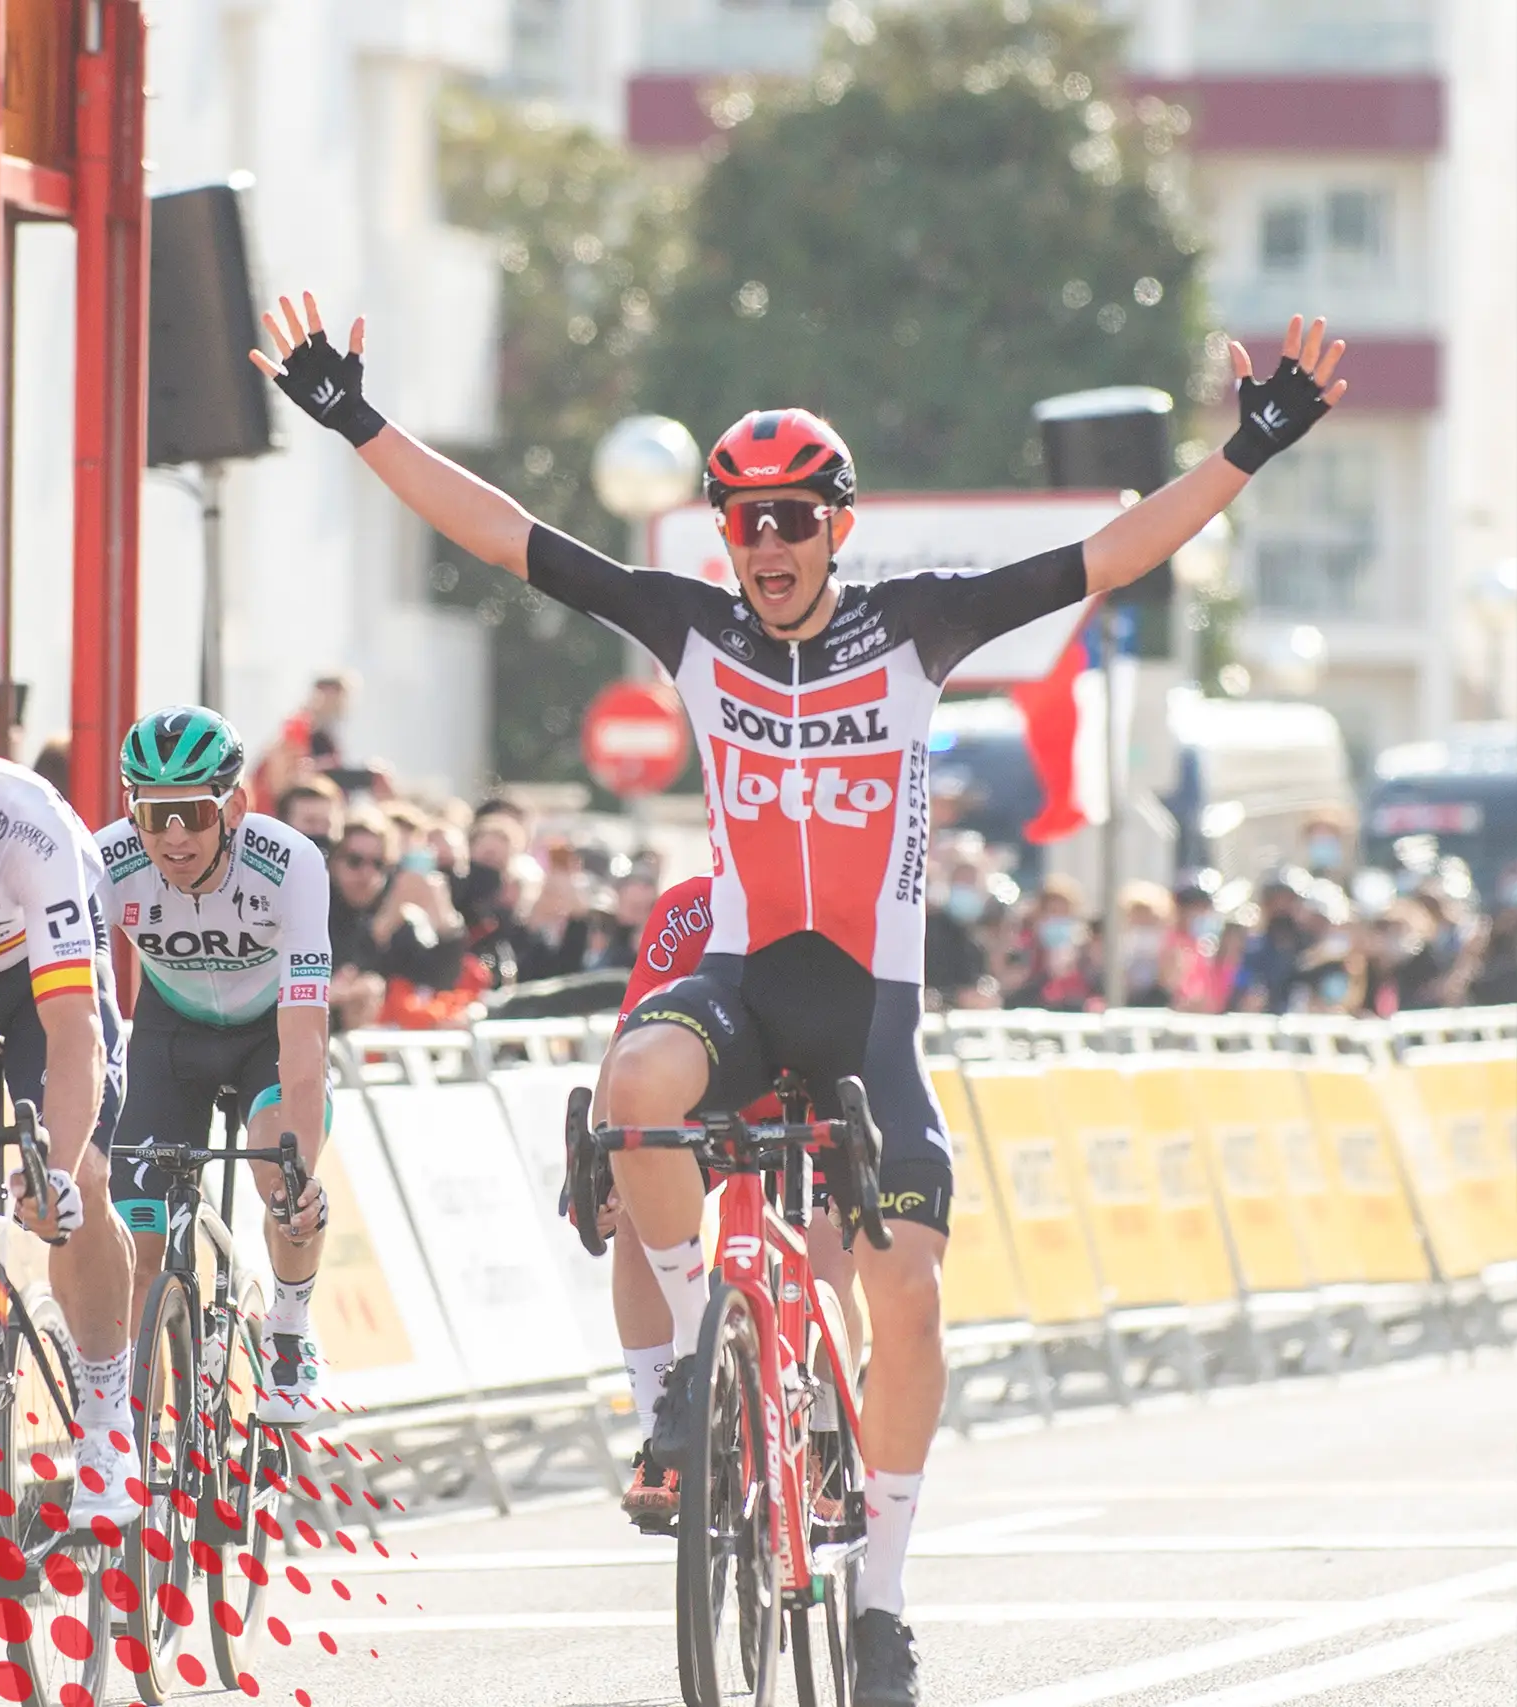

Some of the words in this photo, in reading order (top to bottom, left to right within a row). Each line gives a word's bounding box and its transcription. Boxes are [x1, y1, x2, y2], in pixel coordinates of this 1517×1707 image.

[835, 627, 887, 663] CAPS
[720, 697, 888, 749] SOUDAL
[908, 739, 921, 808] SEALS
[908, 814, 918, 830] &
[244, 828, 291, 868] BORA
[242, 850, 284, 885] hansgrohe
[896, 834, 918, 902] BONDS
[55, 948, 82, 957] TECH
[137, 931, 272, 958] BORA
